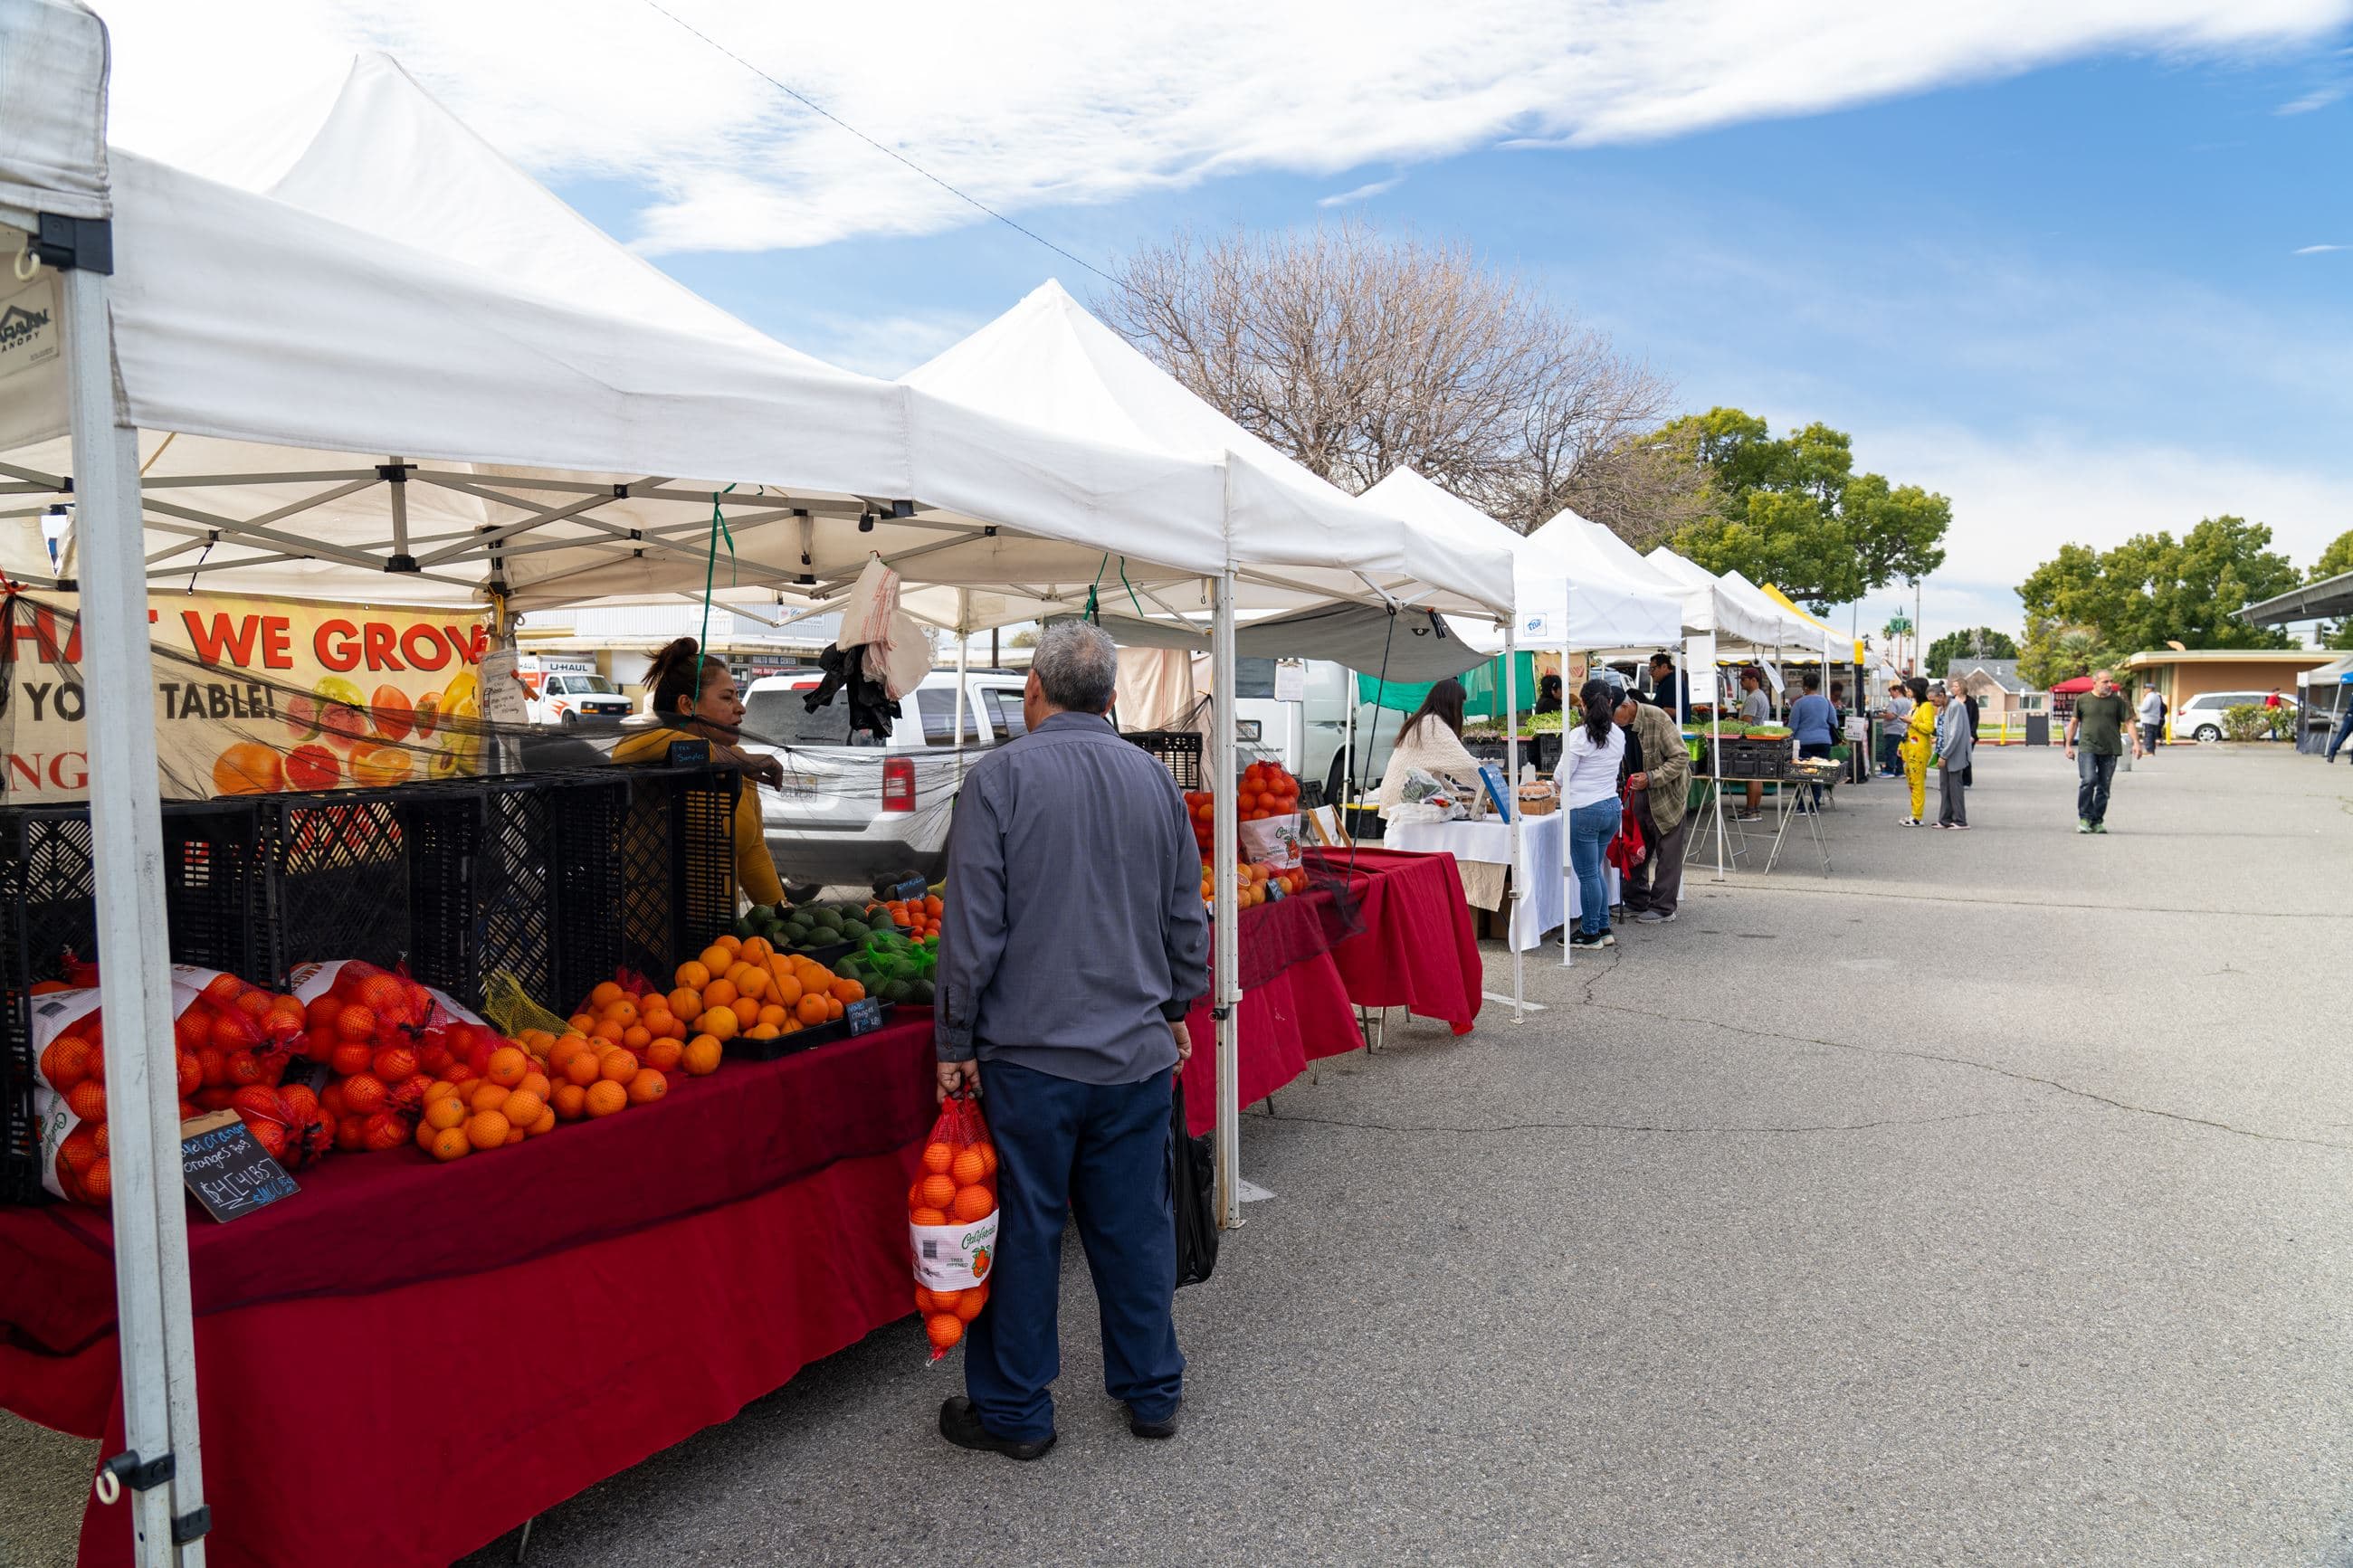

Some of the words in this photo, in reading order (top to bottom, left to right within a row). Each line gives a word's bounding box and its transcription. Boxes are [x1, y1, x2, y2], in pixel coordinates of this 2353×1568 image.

[180, 610, 293, 670] WE
[549, 662, 588, 671] U-HAUL
[159, 682, 276, 719] TABLE!
[184, 1146, 232, 1173] oranges
